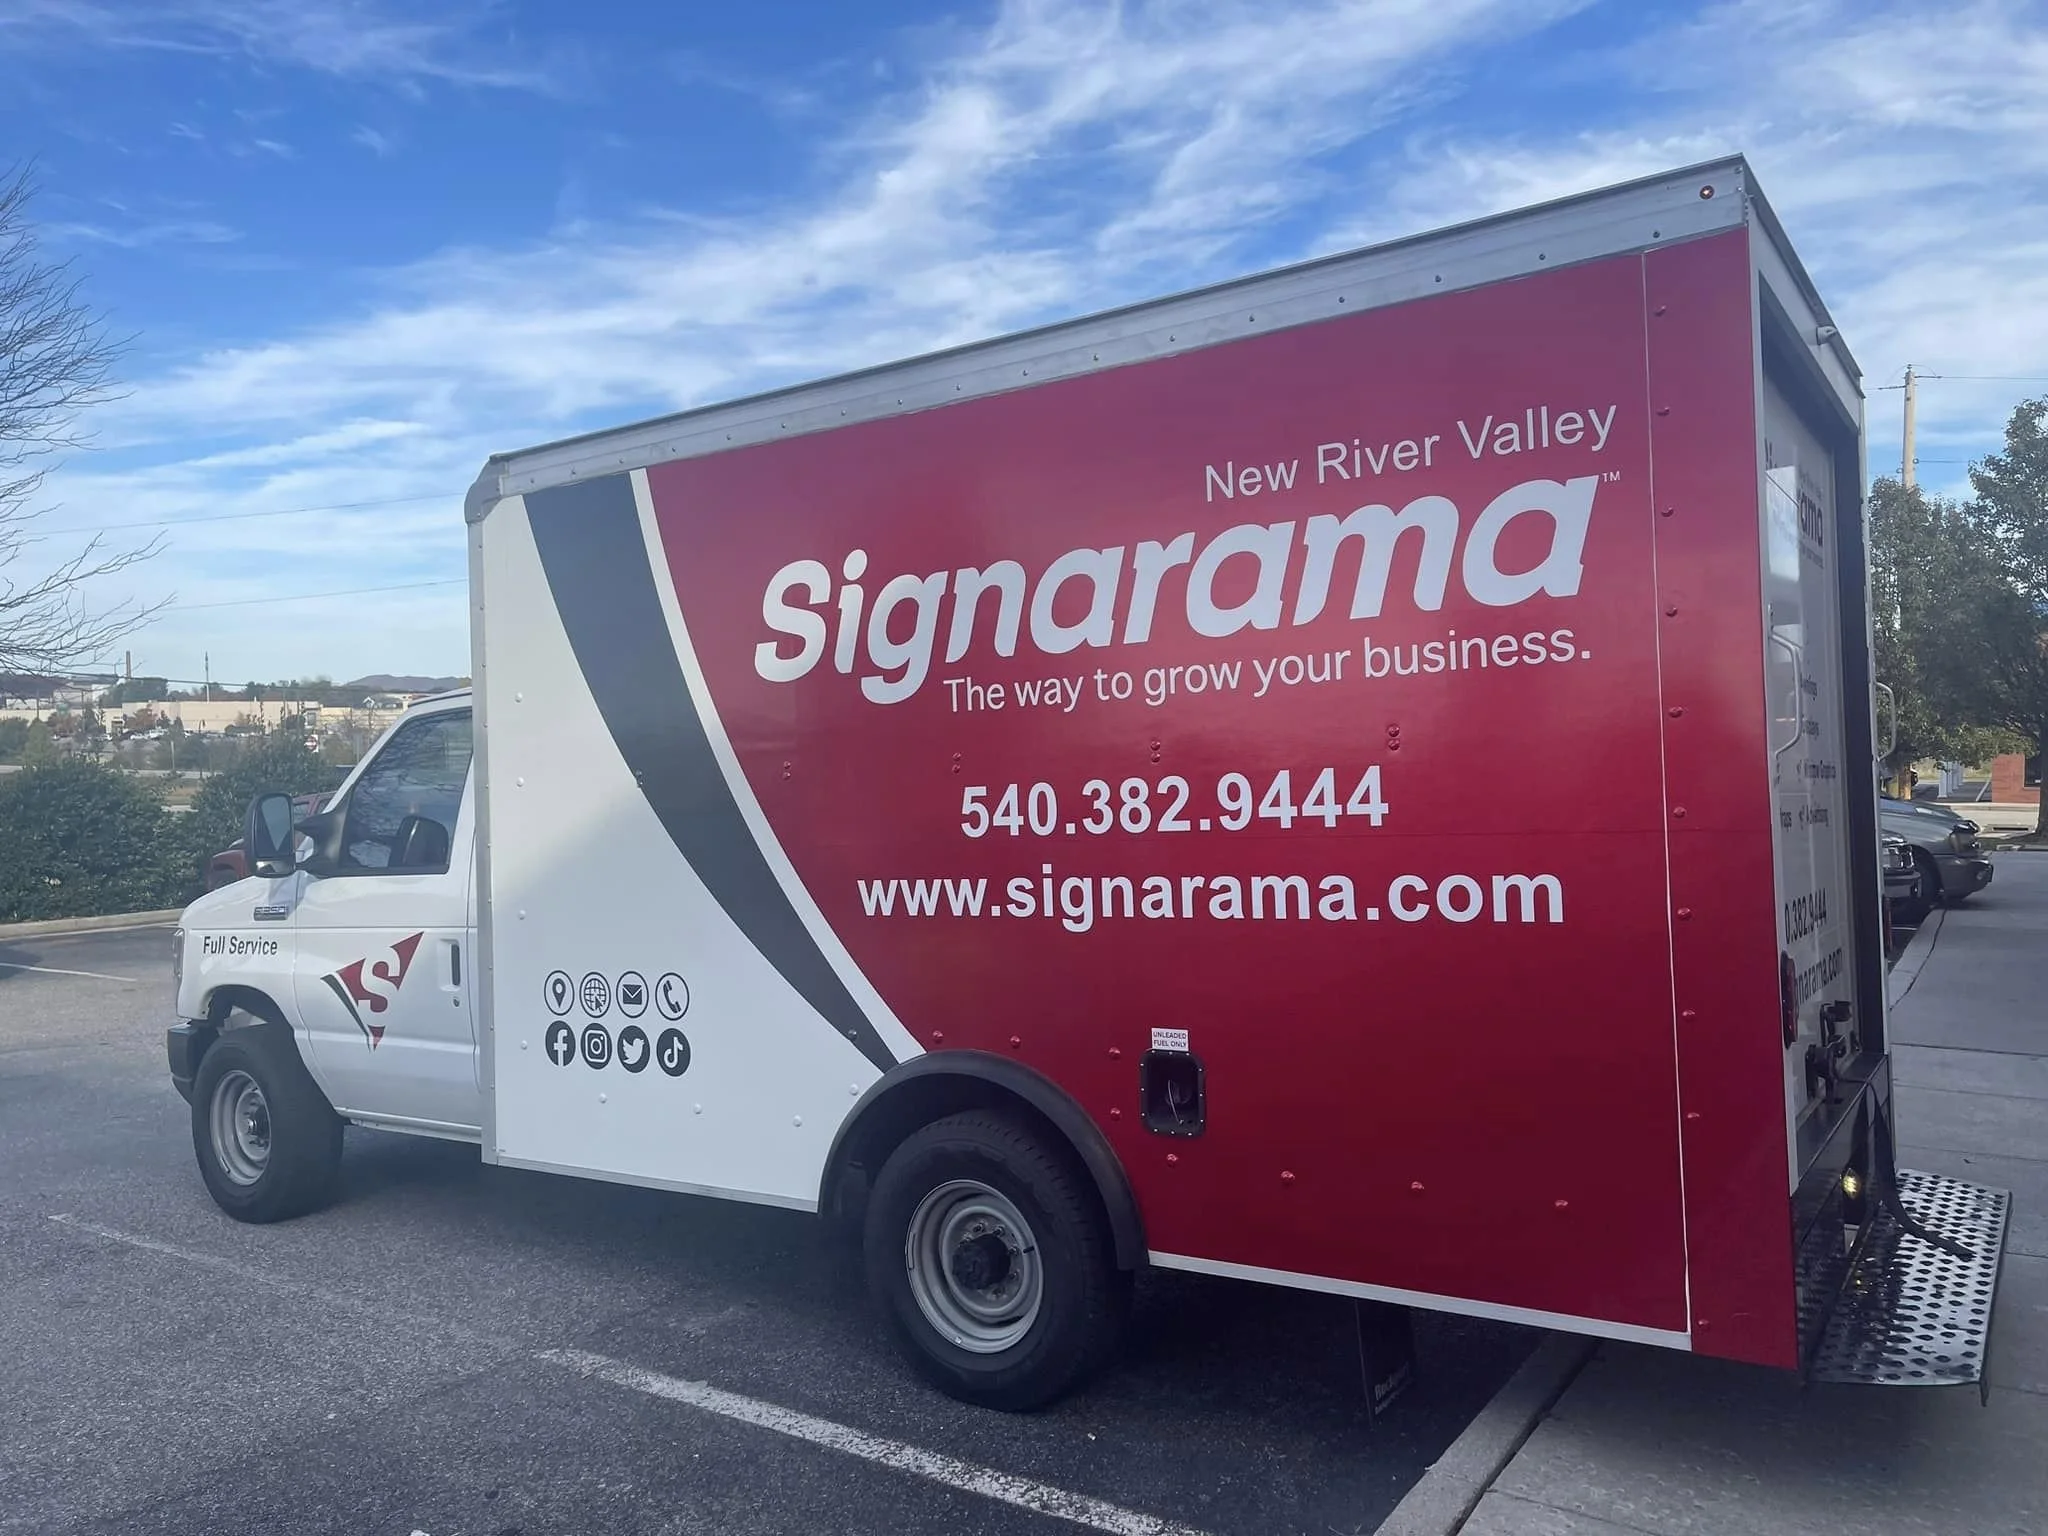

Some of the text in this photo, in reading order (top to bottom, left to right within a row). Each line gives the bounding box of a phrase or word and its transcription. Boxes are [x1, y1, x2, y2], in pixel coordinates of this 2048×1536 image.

[1205, 405, 1617, 503] New River Valley
[754, 474, 1600, 706] Signarama
[942, 629, 1591, 713] The way to grow your business.
[960, 765, 1389, 838] 540.382.9444
[856, 863, 1564, 933] www.signarama.com
[203, 936, 278, 955] Full Service
[1153, 1031, 1187, 1040] UNLEADED
[1170, 1040, 1187, 1048] ONLY
